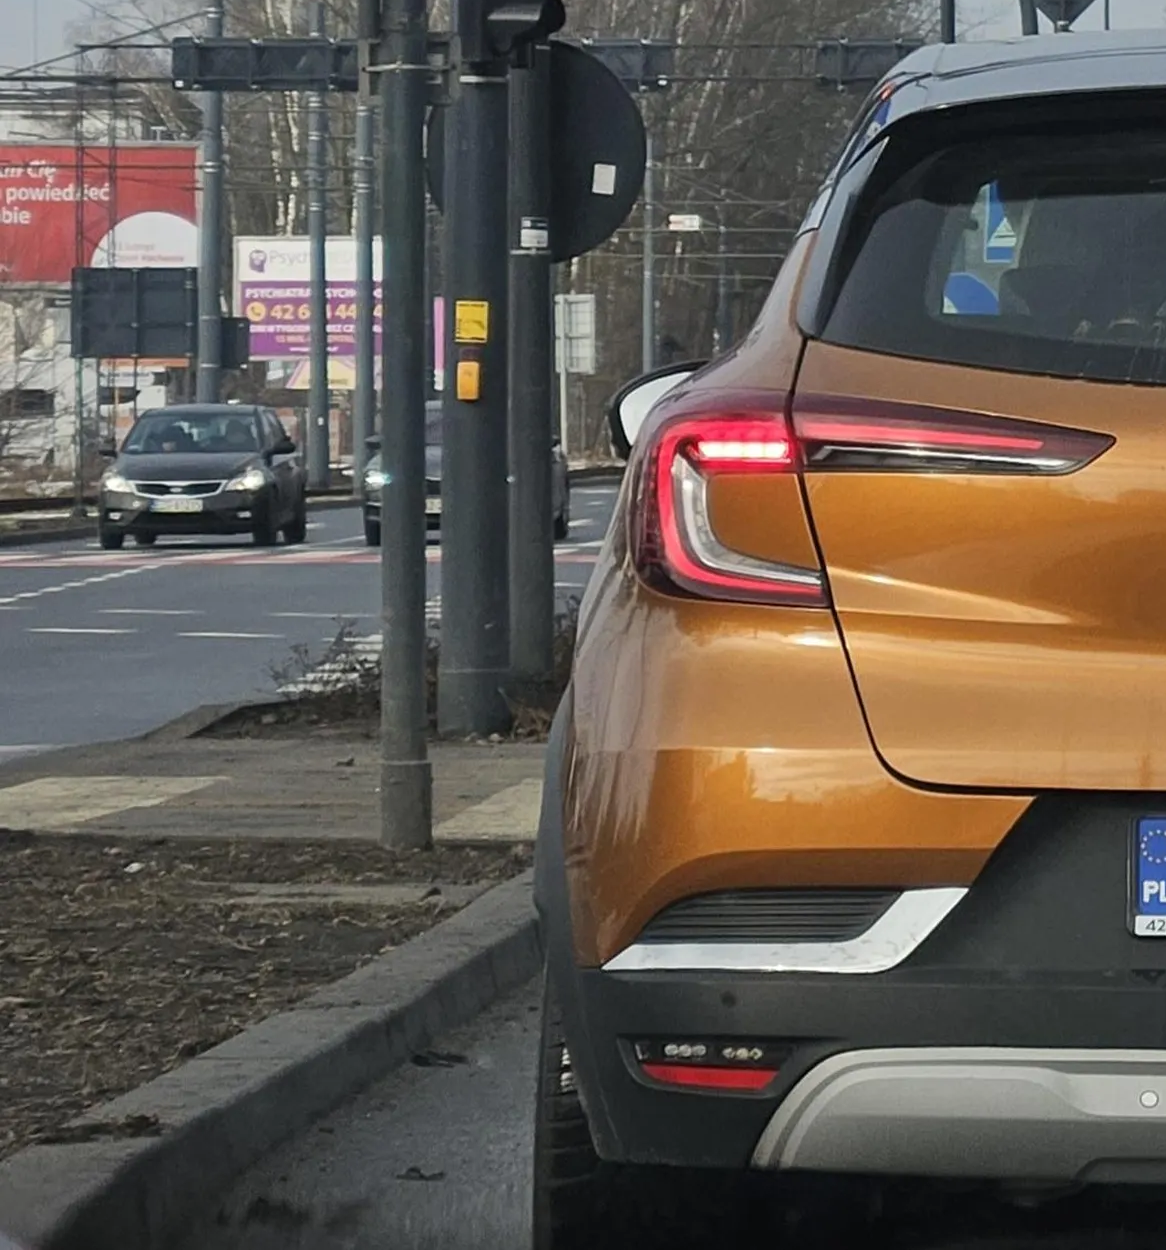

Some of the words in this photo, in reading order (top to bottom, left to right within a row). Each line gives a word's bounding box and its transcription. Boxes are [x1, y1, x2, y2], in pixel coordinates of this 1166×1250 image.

[0, 206, 32, 224] bie
[270, 304, 294, 320] 42
[1146, 919, 1166, 932] 42
